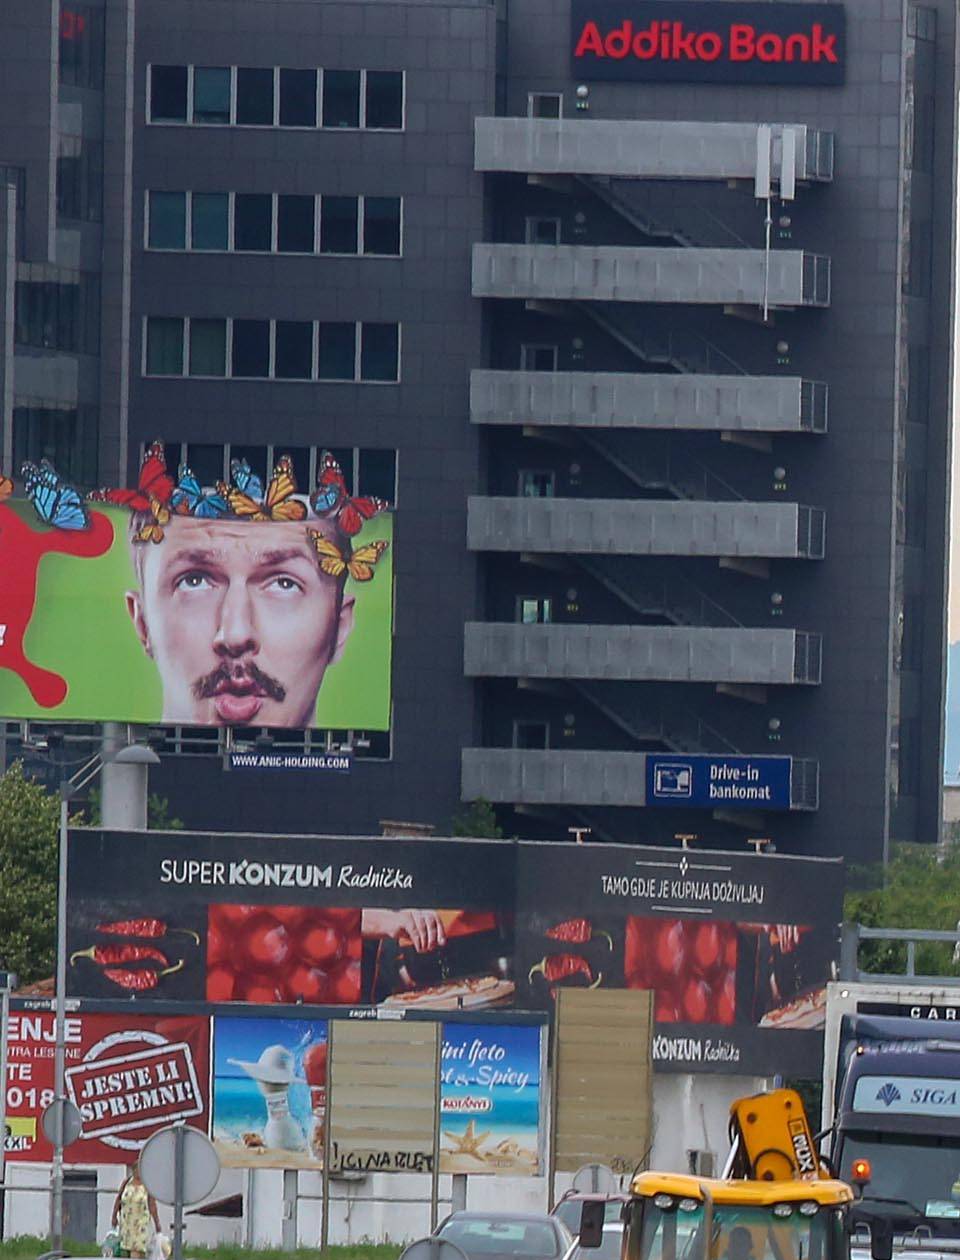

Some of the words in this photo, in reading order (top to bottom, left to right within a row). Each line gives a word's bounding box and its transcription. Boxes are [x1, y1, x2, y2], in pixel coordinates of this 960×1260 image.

[574, 20, 723, 60] Addiko
[728, 24, 838, 62] Bank
[232, 755, 349, 768] WWW.ANIC-HOLDING.COM
[710, 764, 759, 781] Drive-in
[710, 783, 771, 800] bankomat
[160, 859, 225, 885] SUPER
[229, 859, 333, 887] KONZUM
[338, 865, 413, 889] Radnička
[601, 875, 629, 896] TAMO
[630, 878, 656, 898] GDJE
[657, 879, 669, 898] JE
[671, 880, 710, 900] KUPNJA
[712, 880, 764, 904] DOŽIVLJAJ
[349, 1008, 377, 1018] zagreb
[468, 1038, 505, 1067] ljeto
[652, 1034, 702, 1061] KONZUM
[81, 1066, 152, 1098] JESTE
[154, 1060, 180, 1083] LI
[477, 1065, 529, 1093] Spicy
[80, 1081, 193, 1123] SPREMNI!
[910, 1088, 958, 1105] SIGA
